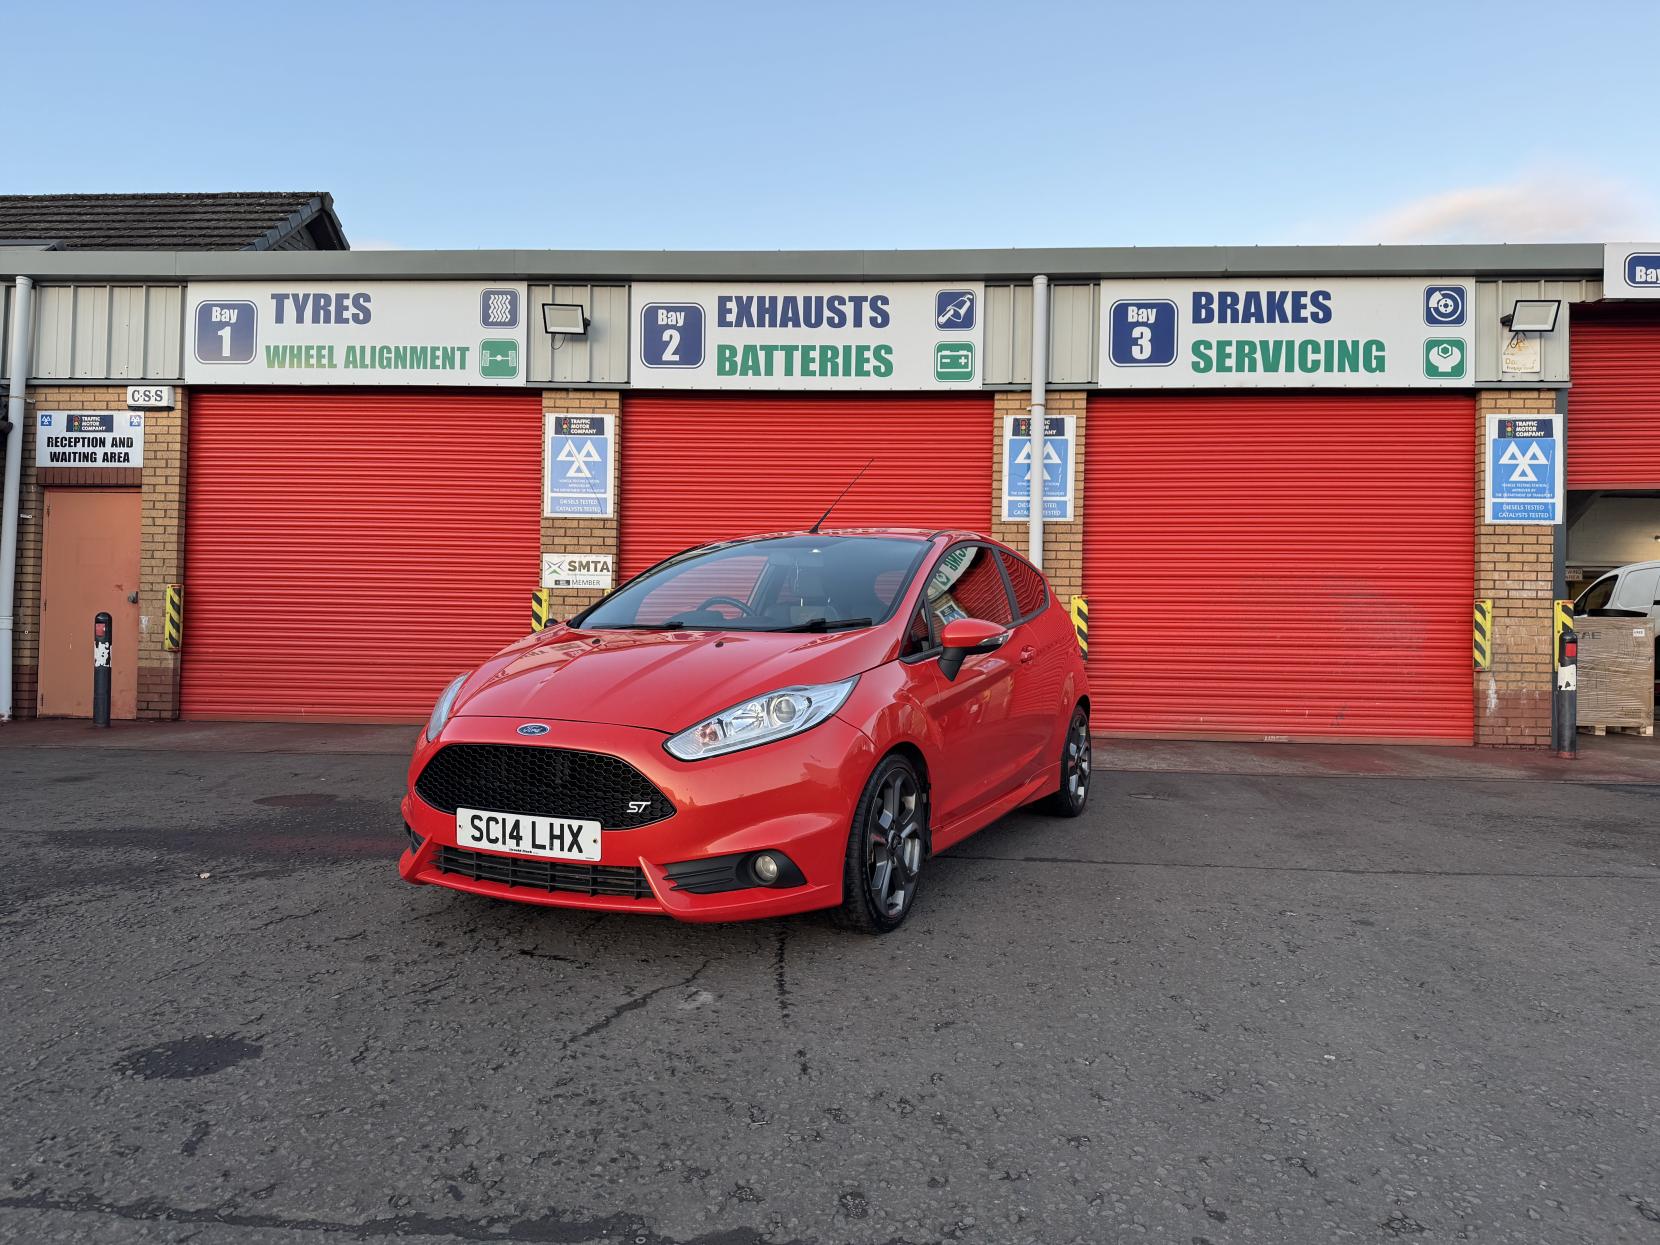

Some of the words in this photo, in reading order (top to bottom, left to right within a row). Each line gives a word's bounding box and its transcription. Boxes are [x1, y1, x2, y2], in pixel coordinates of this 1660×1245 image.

[211, 306, 238, 324] Bay
[271, 293, 371, 325] TYRES
[657, 309, 685, 327] Bay
[717, 294, 890, 328] EXHAUSTS
[1127, 305, 1157, 324] Bay
[1192, 290, 1332, 324] BRAKES
[218, 326, 231, 357] 1
[265, 344, 337, 369] WHEEL
[343, 345, 470, 370] ALIGNMENT
[662, 329, 680, 362] 2
[1131, 326, 1152, 360] 3
[1192, 338, 1387, 374] SERVICING
[716, 343, 894, 377] BATTERIES
[46, 436, 106, 448] RECEPTION
[111, 436, 134, 448] AND
[50, 452, 97, 463] WAITING
[102, 452, 130, 463] AREA
[568, 560, 610, 572] SMTA
[626, 802, 651, 813] ST
[470, 814, 523, 847] SC14
[532, 821, 583, 854] LHX
